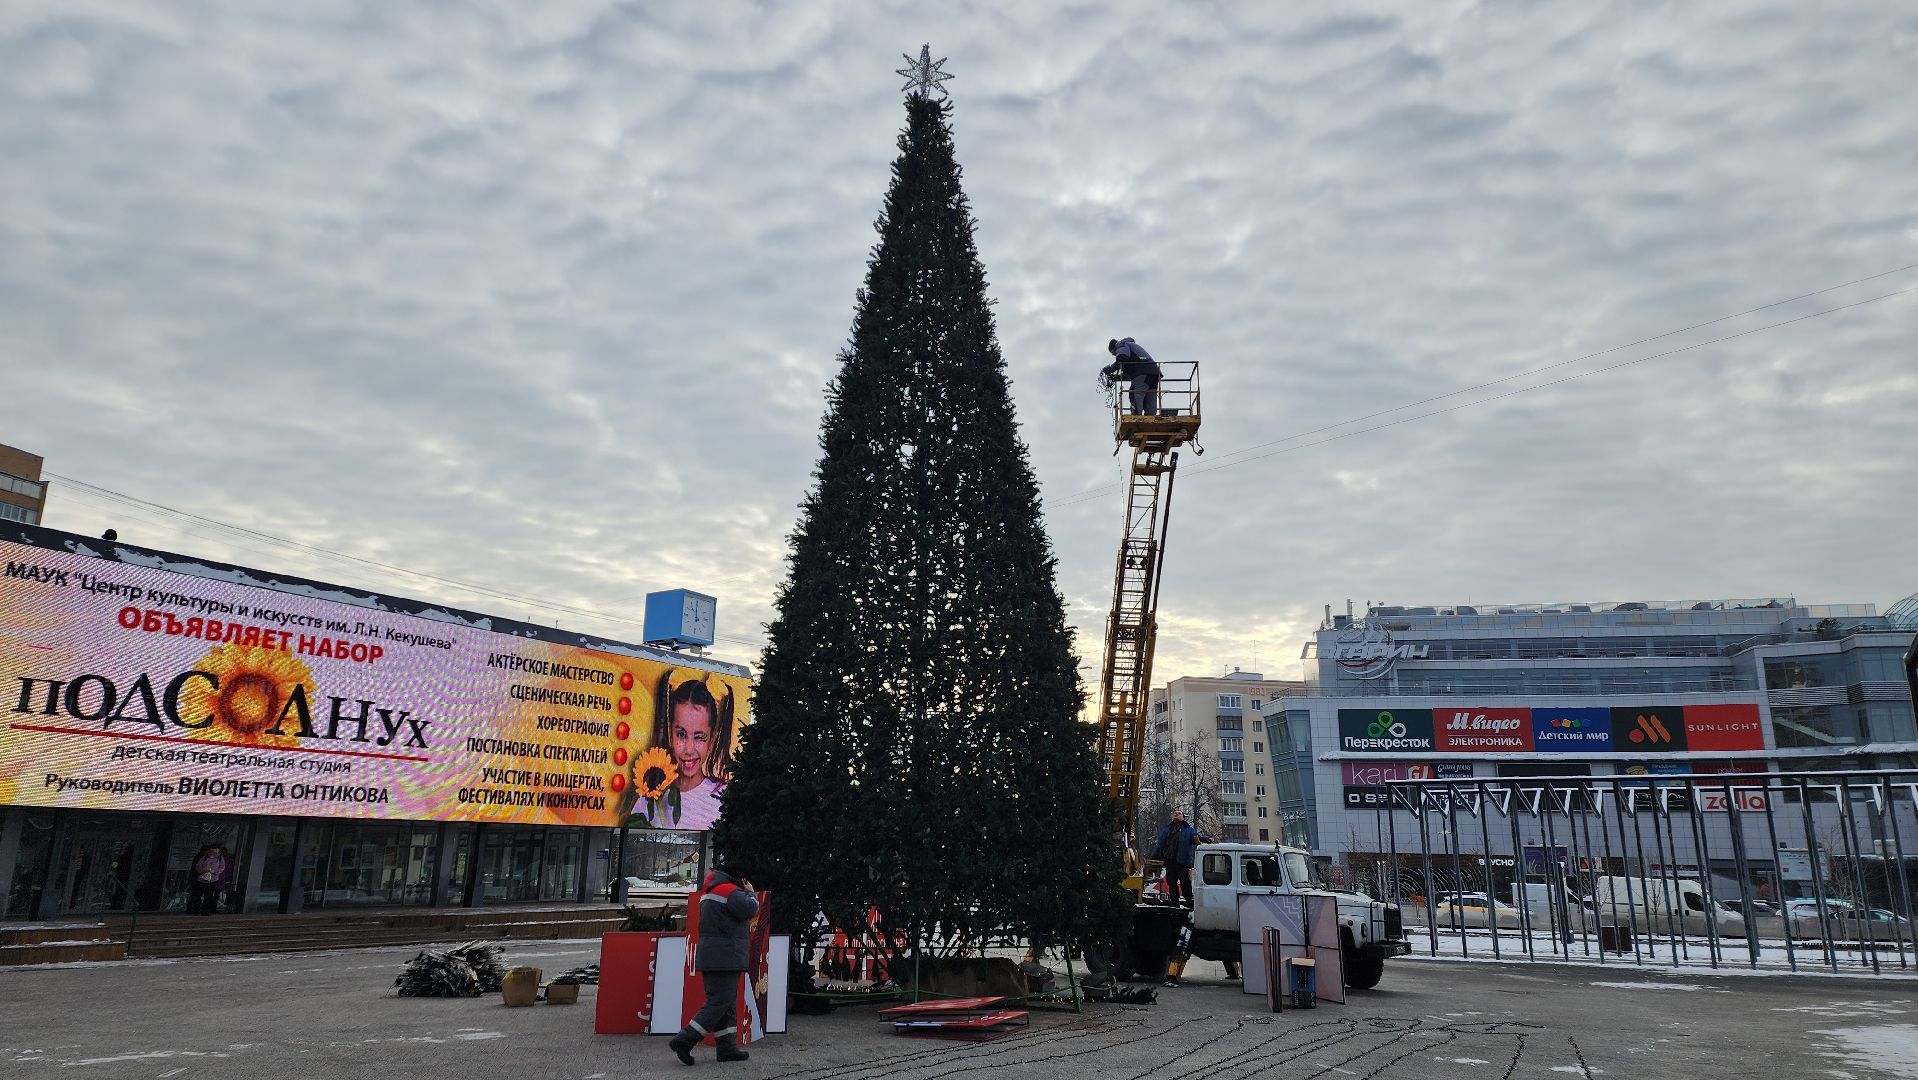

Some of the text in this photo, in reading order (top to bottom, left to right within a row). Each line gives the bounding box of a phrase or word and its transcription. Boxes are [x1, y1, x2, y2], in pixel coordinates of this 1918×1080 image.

[5, 561, 457, 650] МАУК "Центр культуры и искусств им. Л.Н. Кекушева"
[117, 606, 384, 664] ОБЪЯВЛЯЕТ НАБОР
[487, 652, 615, 686] АКТЁРСКОЕ МАСТЕРСТВО
[510, 684, 612, 711] СЦЕНИЧЕСКАЯ РЕЧЬ
[537, 715, 610, 738] ХОРЕОГРАФИЯ
[1446, 713, 1521, 734] М.видео
[1538, 729, 1609, 742] Детский мир
[1688, 722, 1758, 732] SUNLIGHT
[466, 737, 608, 764] ПОСТАНОВКА СПЕКТАКЛЕЙ
[1344, 736, 1431, 751] Перекресток
[1448, 737, 1523, 747] ЭЛЕКТРОНИКА
[111, 744, 352, 774] детская театральная студия
[481, 767, 605, 792] УЧАСТИЕ В КОНЦЕРТАХ,
[1351, 761, 1397, 785] kari
[45, 773, 390, 804] Руководитель ВИОЛЕТТА ОНТИКОВА
[457, 787, 606, 811] ФЕСТИВАЛЯХ И КОНКУРСАХ
[1478, 858, 1514, 866] ВУСНО
